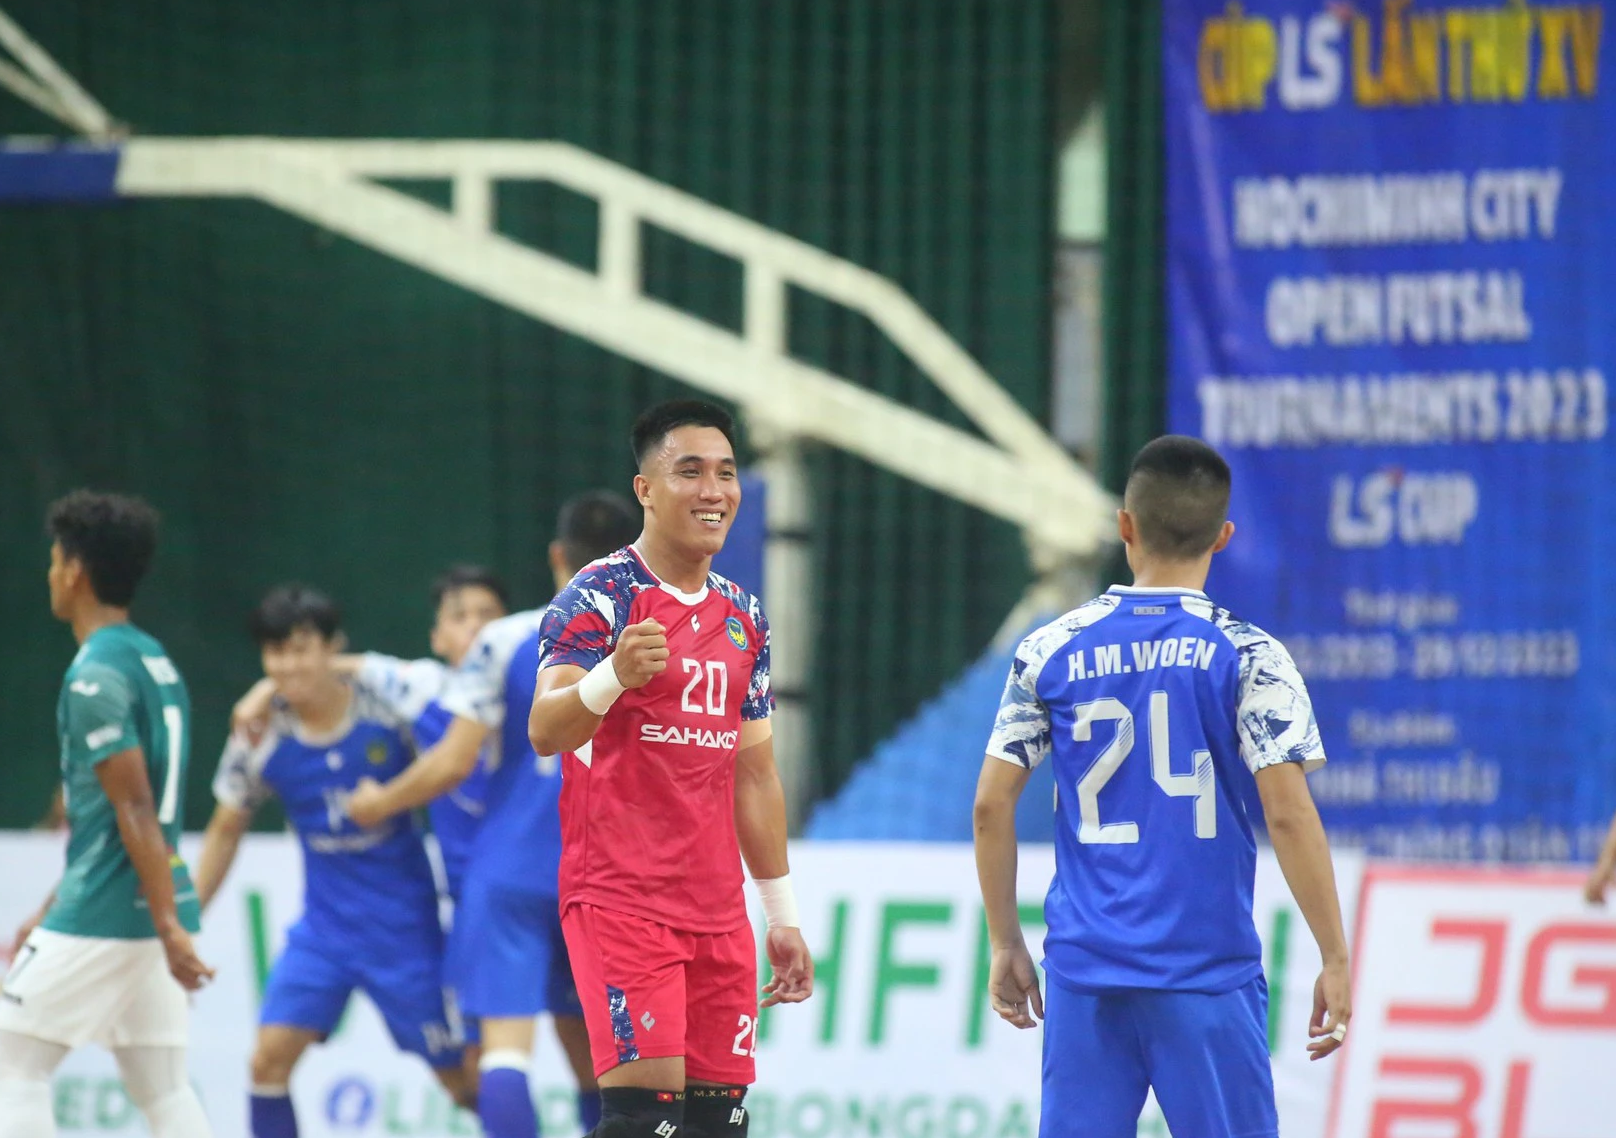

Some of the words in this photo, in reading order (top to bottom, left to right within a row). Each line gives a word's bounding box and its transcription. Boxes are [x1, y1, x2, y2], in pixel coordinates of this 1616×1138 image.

[1278, 14, 1342, 110] LS
[1536, 8, 1602, 99] XV
[1471, 167, 1563, 242] CITY
[1266, 276, 1382, 346] OPEN
[1386, 270, 1532, 342] FUTSAL
[1199, 374, 1499, 447] TOURNAMENTS
[1506, 369, 1607, 440] 2023
[681, 657, 728, 716] 20
[1068, 637, 1216, 682] H.M.WOEN
[1072, 690, 1218, 844] 24
